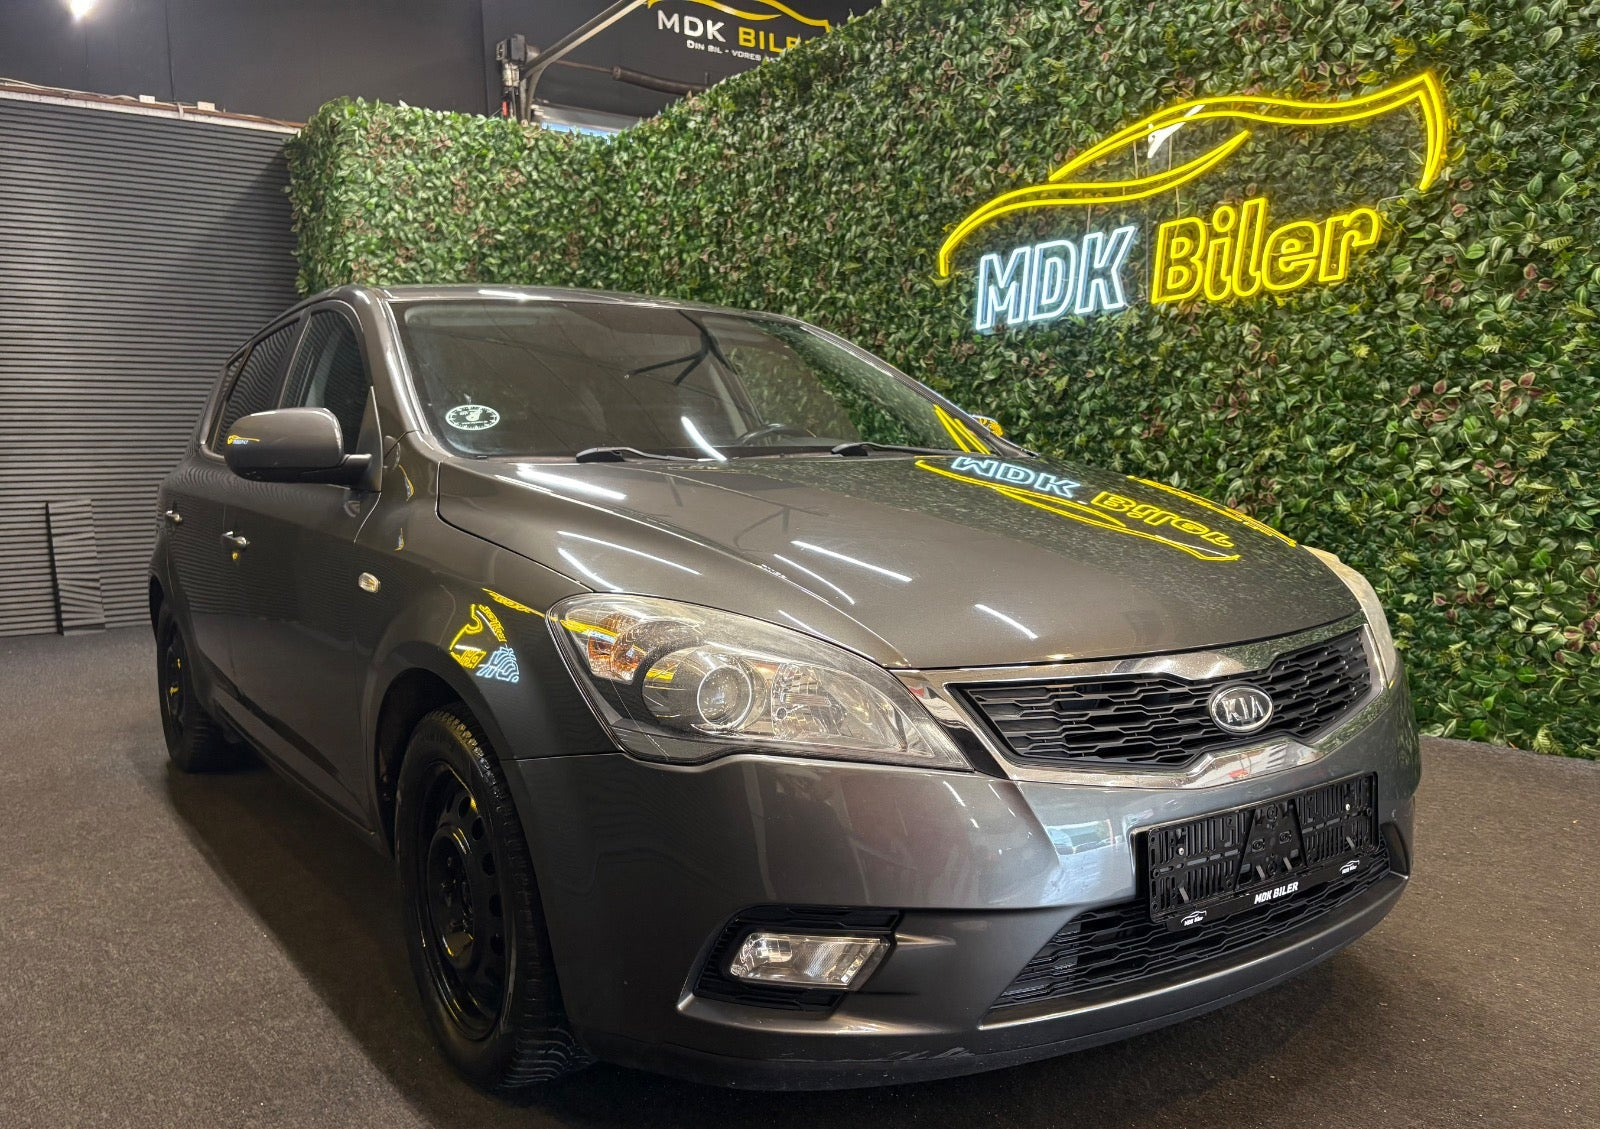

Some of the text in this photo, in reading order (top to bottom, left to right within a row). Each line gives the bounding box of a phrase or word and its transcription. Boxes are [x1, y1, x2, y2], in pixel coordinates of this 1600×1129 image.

[657, 10, 811, 53] MDK BILE
[975, 196, 1383, 331] MDK Biler
[1220, 695, 1265, 723] KIA
[1253, 881, 1299, 905] MDK BILER
